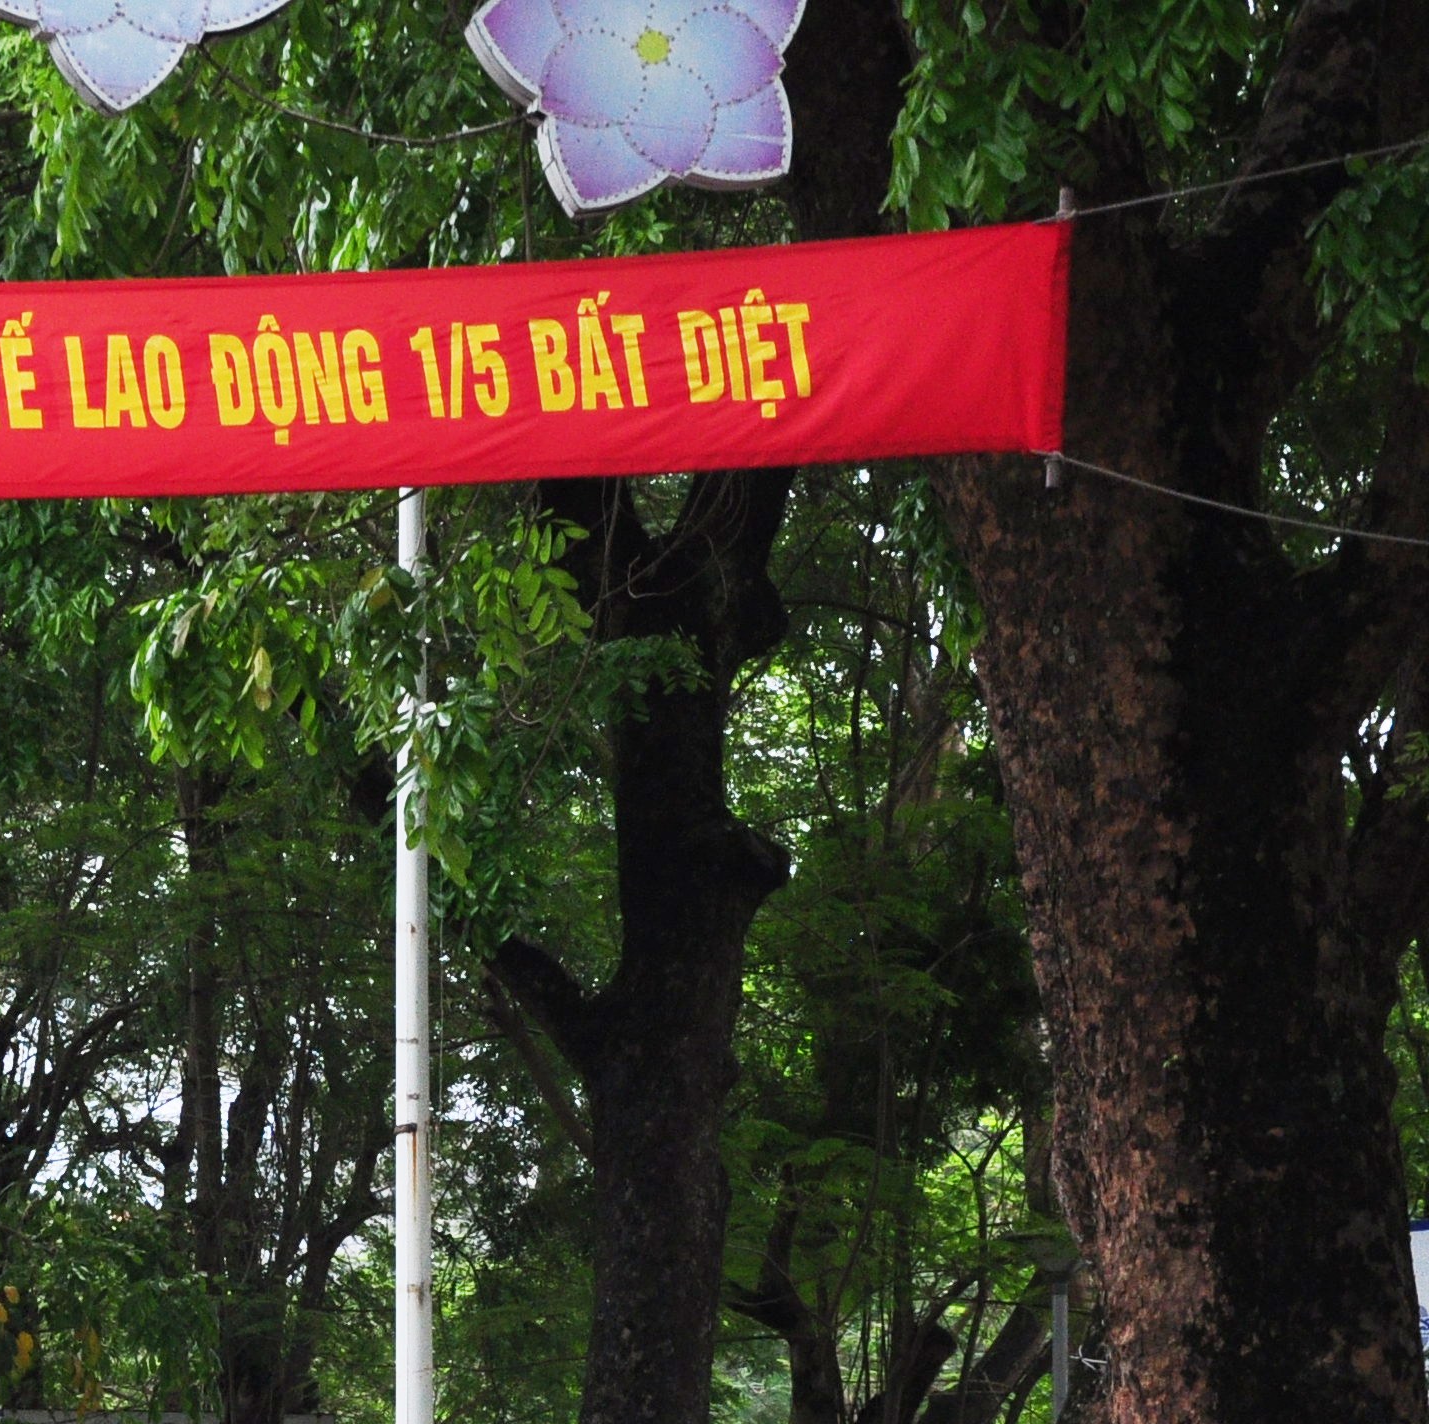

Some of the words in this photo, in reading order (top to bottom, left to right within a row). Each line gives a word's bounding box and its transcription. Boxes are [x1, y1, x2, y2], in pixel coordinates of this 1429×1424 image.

[69, 333, 185, 429] LAO
[210, 313, 389, 446] ĐỘNG
[409, 321, 509, 418] 1/5
[528, 290, 649, 412] BẤT
[678, 287, 813, 419] DIỆT
